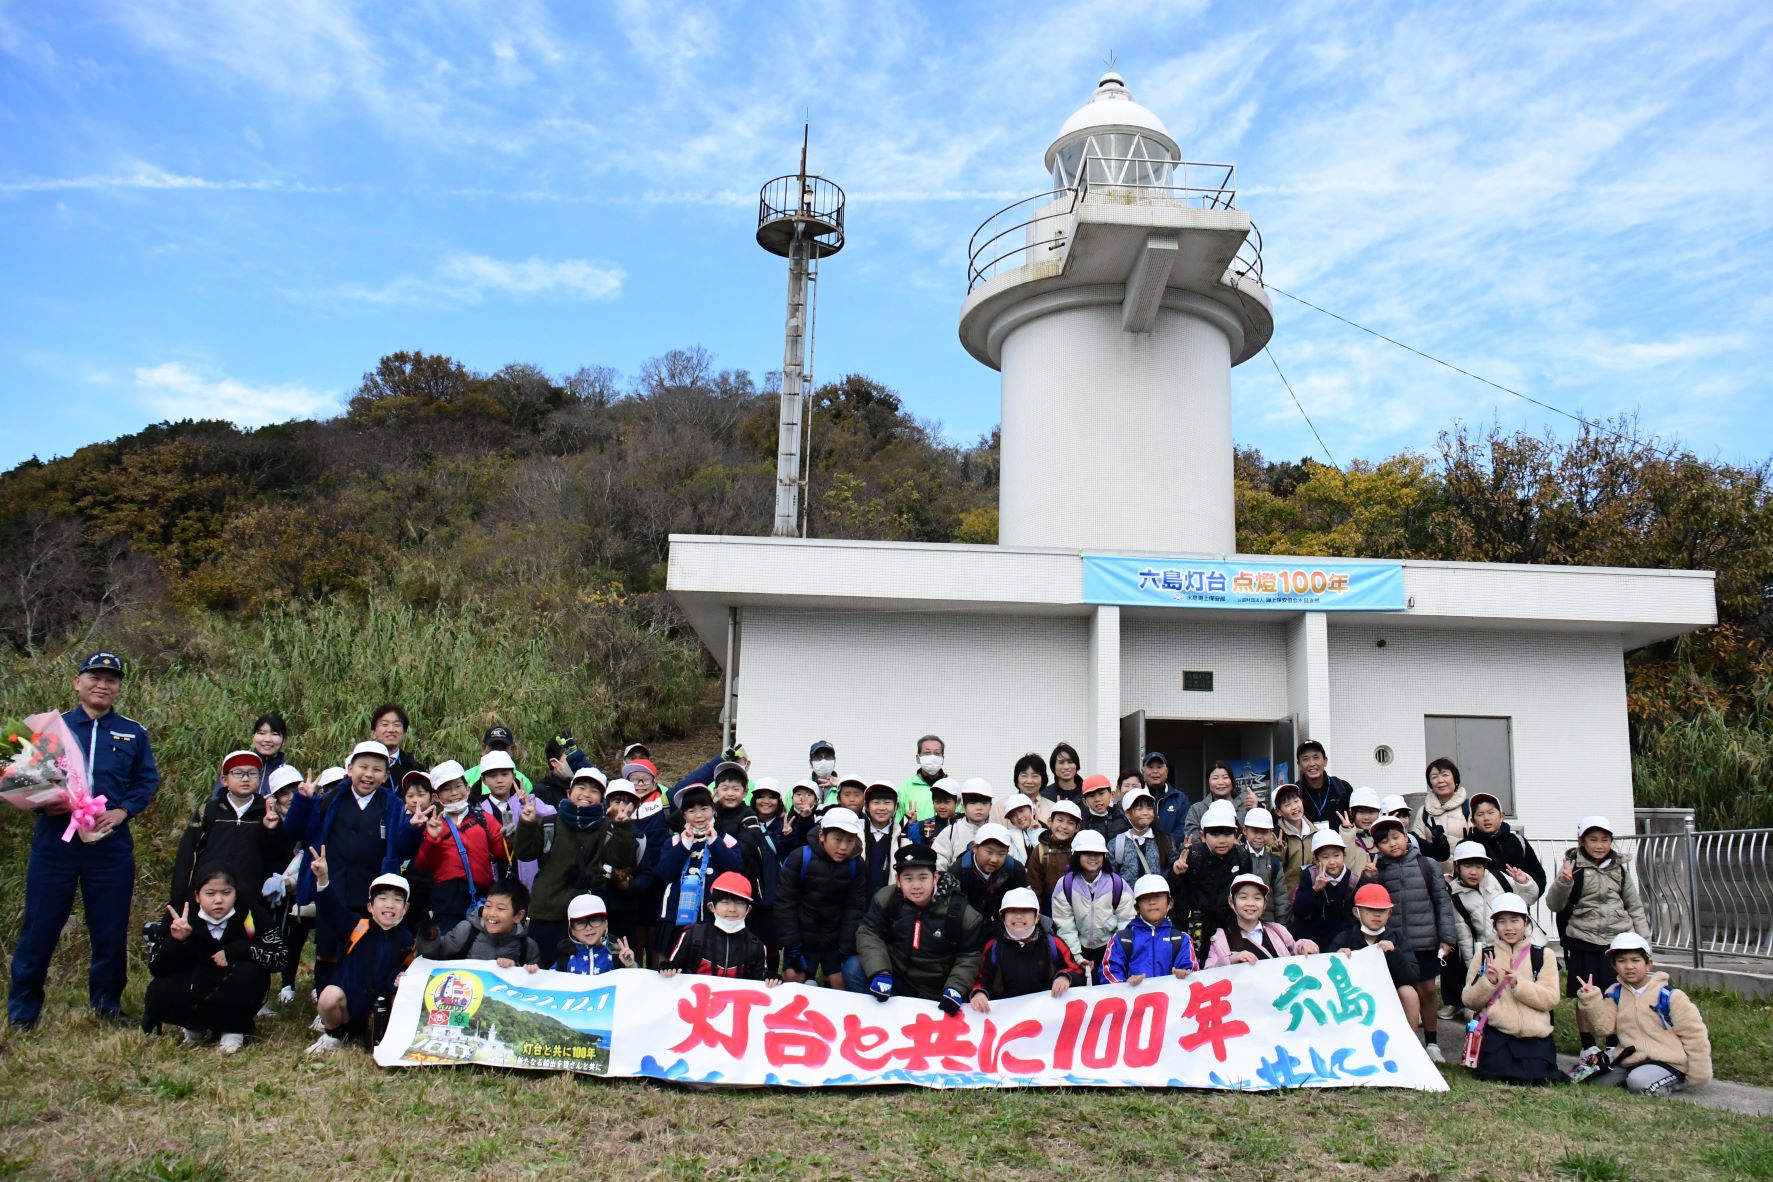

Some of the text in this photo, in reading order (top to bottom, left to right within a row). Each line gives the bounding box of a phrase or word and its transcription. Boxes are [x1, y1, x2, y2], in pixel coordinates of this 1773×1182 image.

[1139, 569, 1349, 594] 六島灯台 点燈100年
[488, 984, 610, 1012] 2022.12.1
[1272, 955, 1376, 1032] 六島
[671, 978, 1250, 1074] 灯台と共に100年
[522, 1041, 597, 1060] 灯台と共に100年
